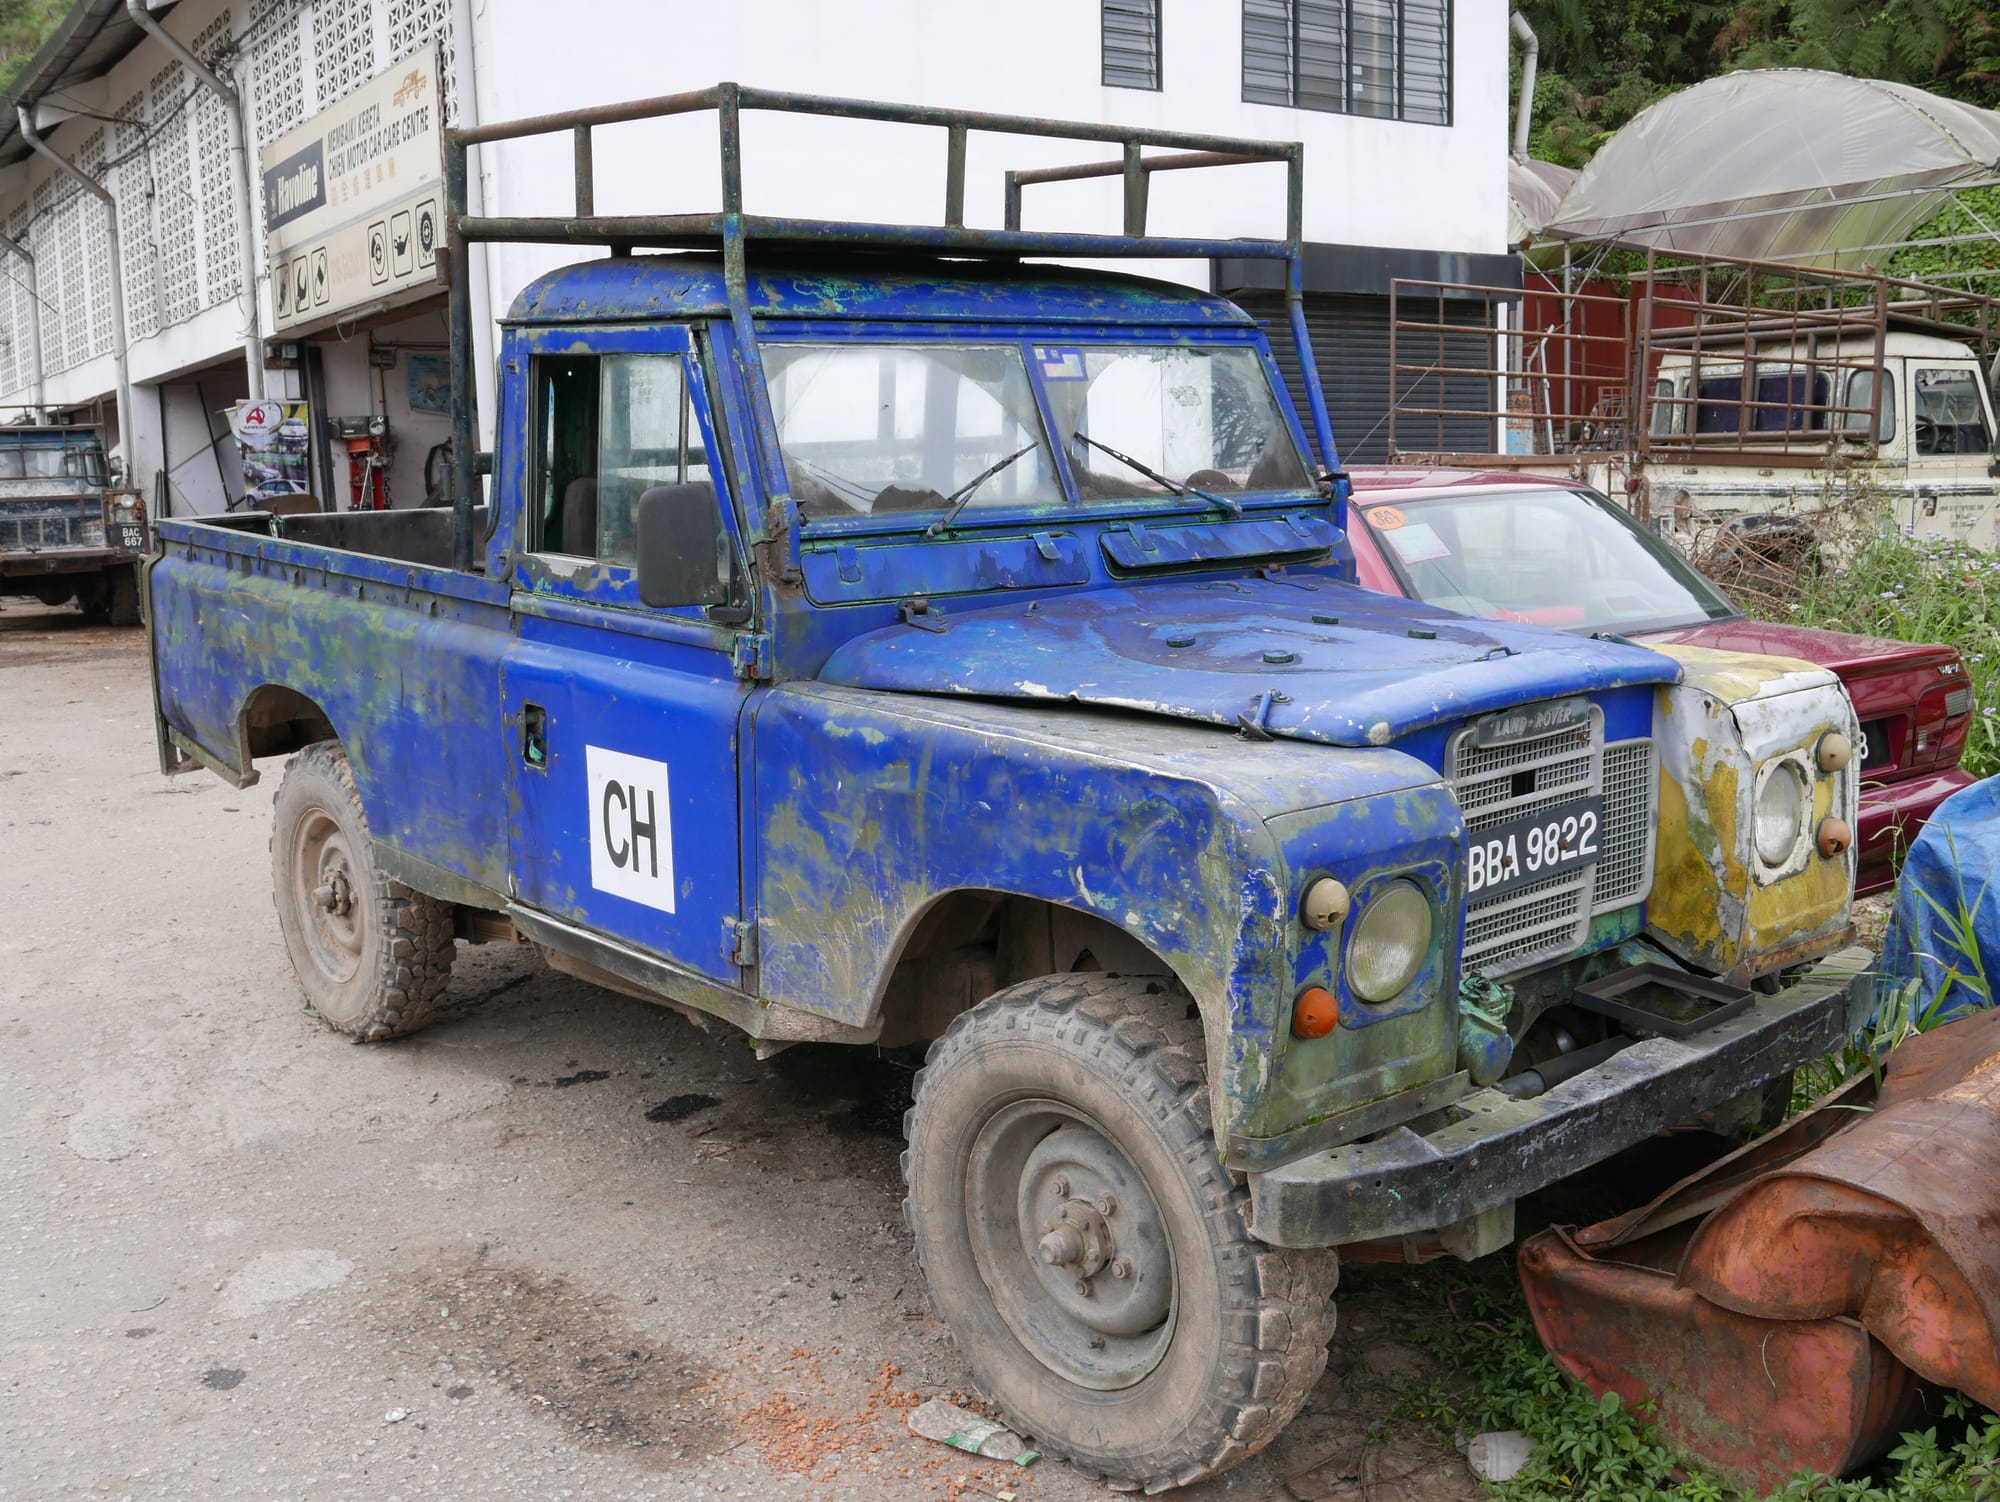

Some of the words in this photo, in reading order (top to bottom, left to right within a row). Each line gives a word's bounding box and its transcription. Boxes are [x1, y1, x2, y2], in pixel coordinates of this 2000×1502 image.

[328, 116, 357, 154] MEMBAIKI
[357, 102, 380, 136] KERETA
[346, 138, 368, 171] MOTOR
[369, 131, 382, 159] CAR
[383, 121, 400, 152] CARE
[402, 105, 429, 142] CENTRE
[277, 163, 318, 216] Havoline
[122, 527, 140, 537] BAC
[124, 537, 143, 546] 667
[603, 779, 659, 878] CH
[1468, 834, 1520, 893] BBA
[1526, 811, 1597, 872] 9822
